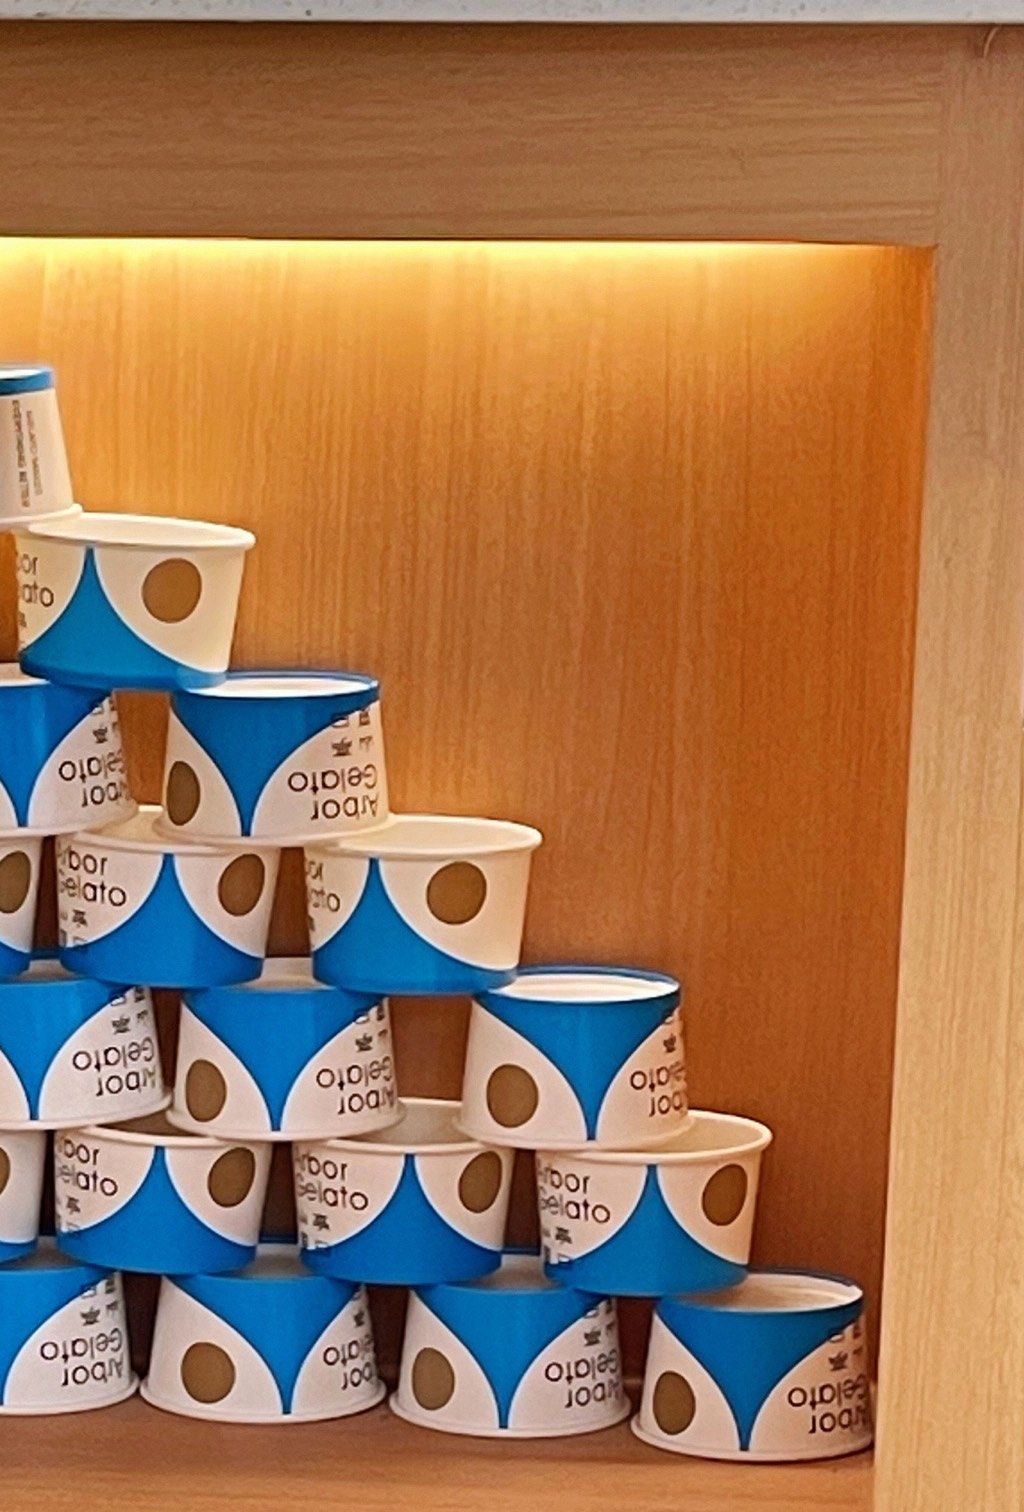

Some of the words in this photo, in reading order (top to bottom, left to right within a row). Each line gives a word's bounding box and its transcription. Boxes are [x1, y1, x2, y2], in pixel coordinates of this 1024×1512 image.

[288, 765, 377, 794] Gelato
[82, 782, 122, 808] bor
[310, 794, 378, 821] Arbor
[64, 847, 107, 875] bor
[72, 1037, 154, 1072] Gelato
[650, 1092, 683, 1117] bor
[62, 1138, 99, 1165] bor
[40, 1328, 122, 1363] Gelato
[323, 1340, 362, 1367] ato
